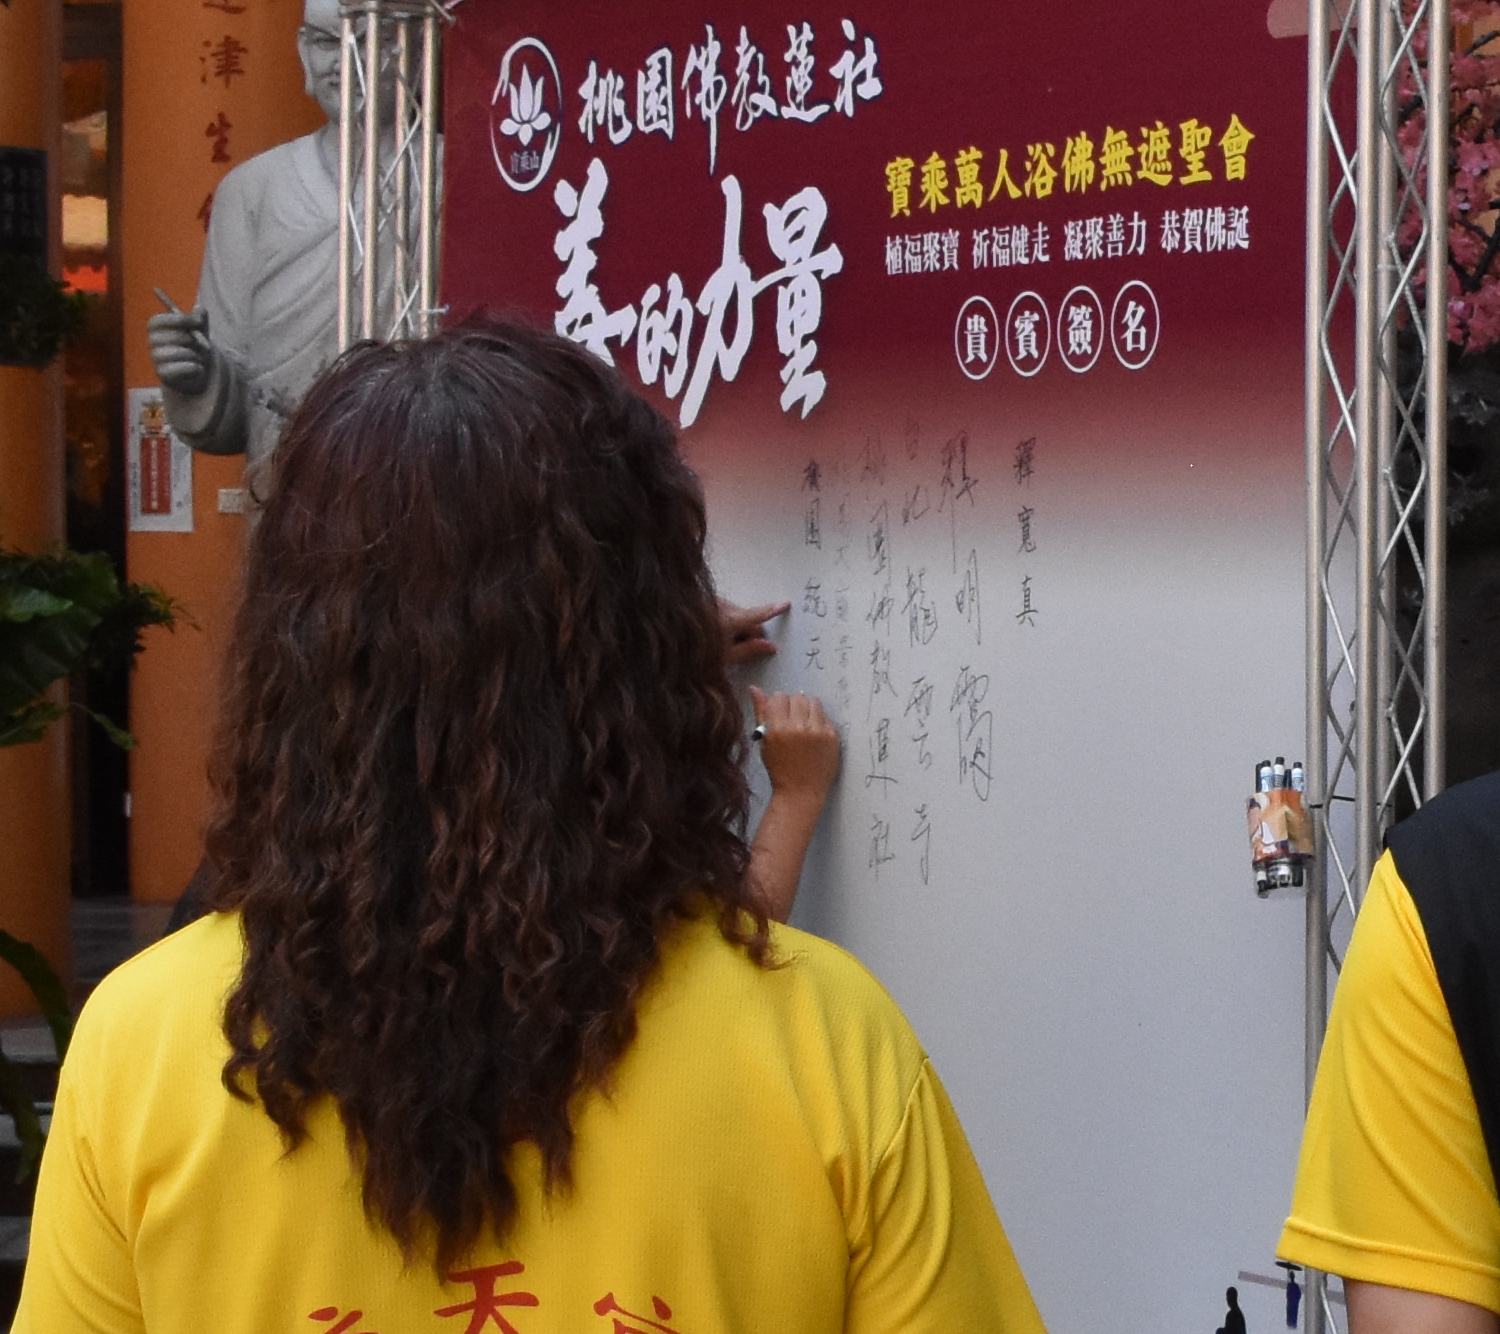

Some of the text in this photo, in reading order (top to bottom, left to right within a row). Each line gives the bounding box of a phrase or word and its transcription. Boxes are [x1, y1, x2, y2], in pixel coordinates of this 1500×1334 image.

[577, 18, 884, 176] 桃園佛教蓮社
[884, 113, 1256, 218] 寶乘萬人浴佛無遮聖會
[885, 205, 1250, 276] 植福聚寶 祈福健走 凝聚善力 恭賀佛誕
